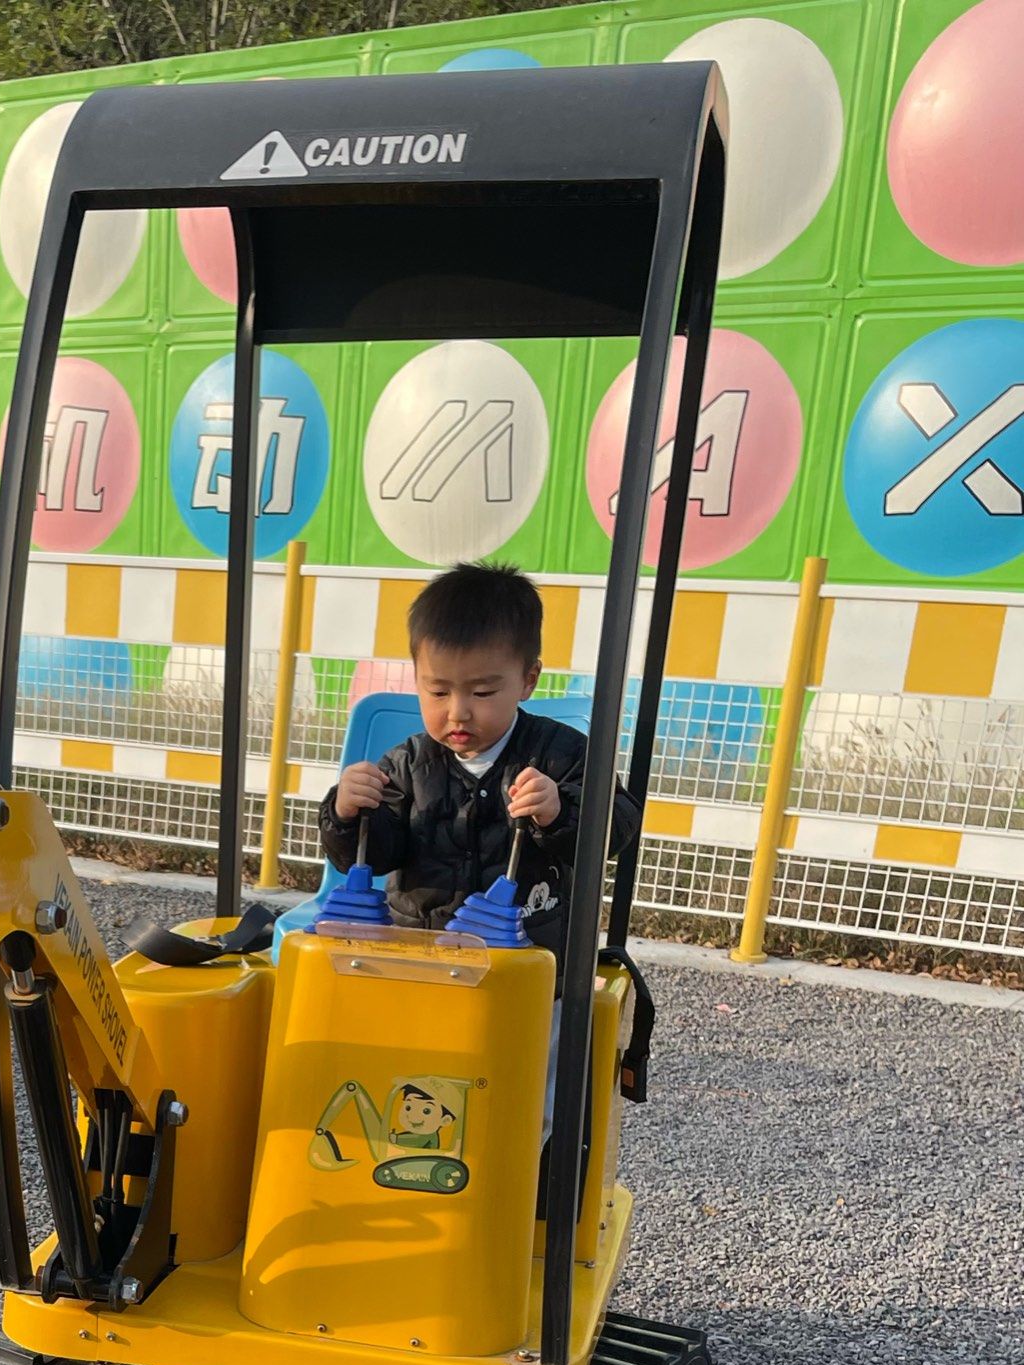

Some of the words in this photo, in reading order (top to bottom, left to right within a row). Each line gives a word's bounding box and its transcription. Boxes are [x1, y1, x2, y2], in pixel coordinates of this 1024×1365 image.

[304, 133, 467, 167] CAUTION
[77, 936, 106, 1014] POWER
[101, 992, 128, 1068] SHOVEL
